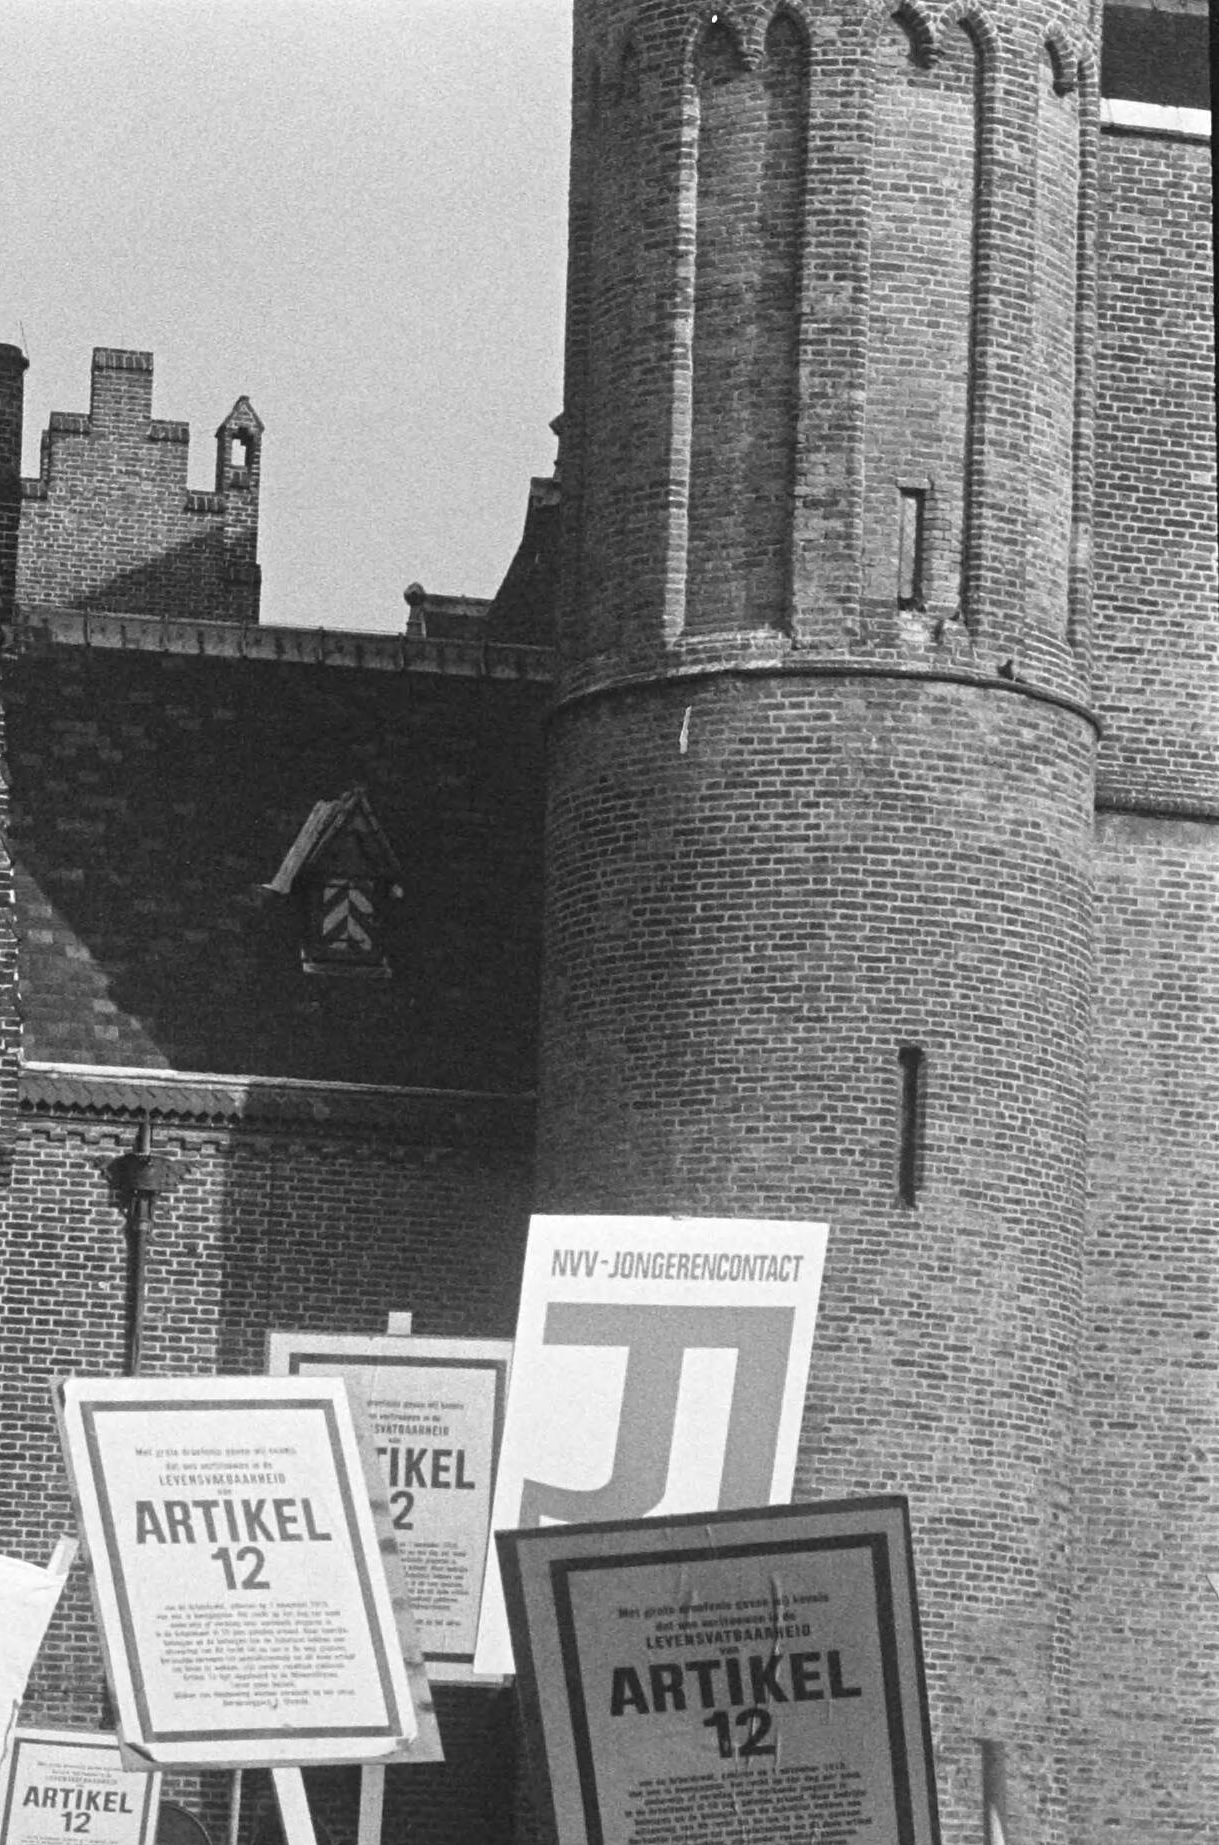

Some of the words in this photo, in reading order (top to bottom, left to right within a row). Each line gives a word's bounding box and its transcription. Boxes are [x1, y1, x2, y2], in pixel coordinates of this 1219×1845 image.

[551, 1248, 804, 1284] NVV-JONGERENCONTACT
[371, 1423, 450, 1437] SVATBAARHEID
[376, 1447, 476, 1490] IKEL
[136, 1498, 333, 1545] ARTIKEL
[390, 1491, 414, 1531] 2
[211, 1546, 271, 1591] 12
[610, 1650, 862, 1717] ARTIKEL
[703, 1707, 777, 1759] 12
[22, 1786, 133, 1814] ARTIKEL
[61, 1812, 91, 1834] 12
